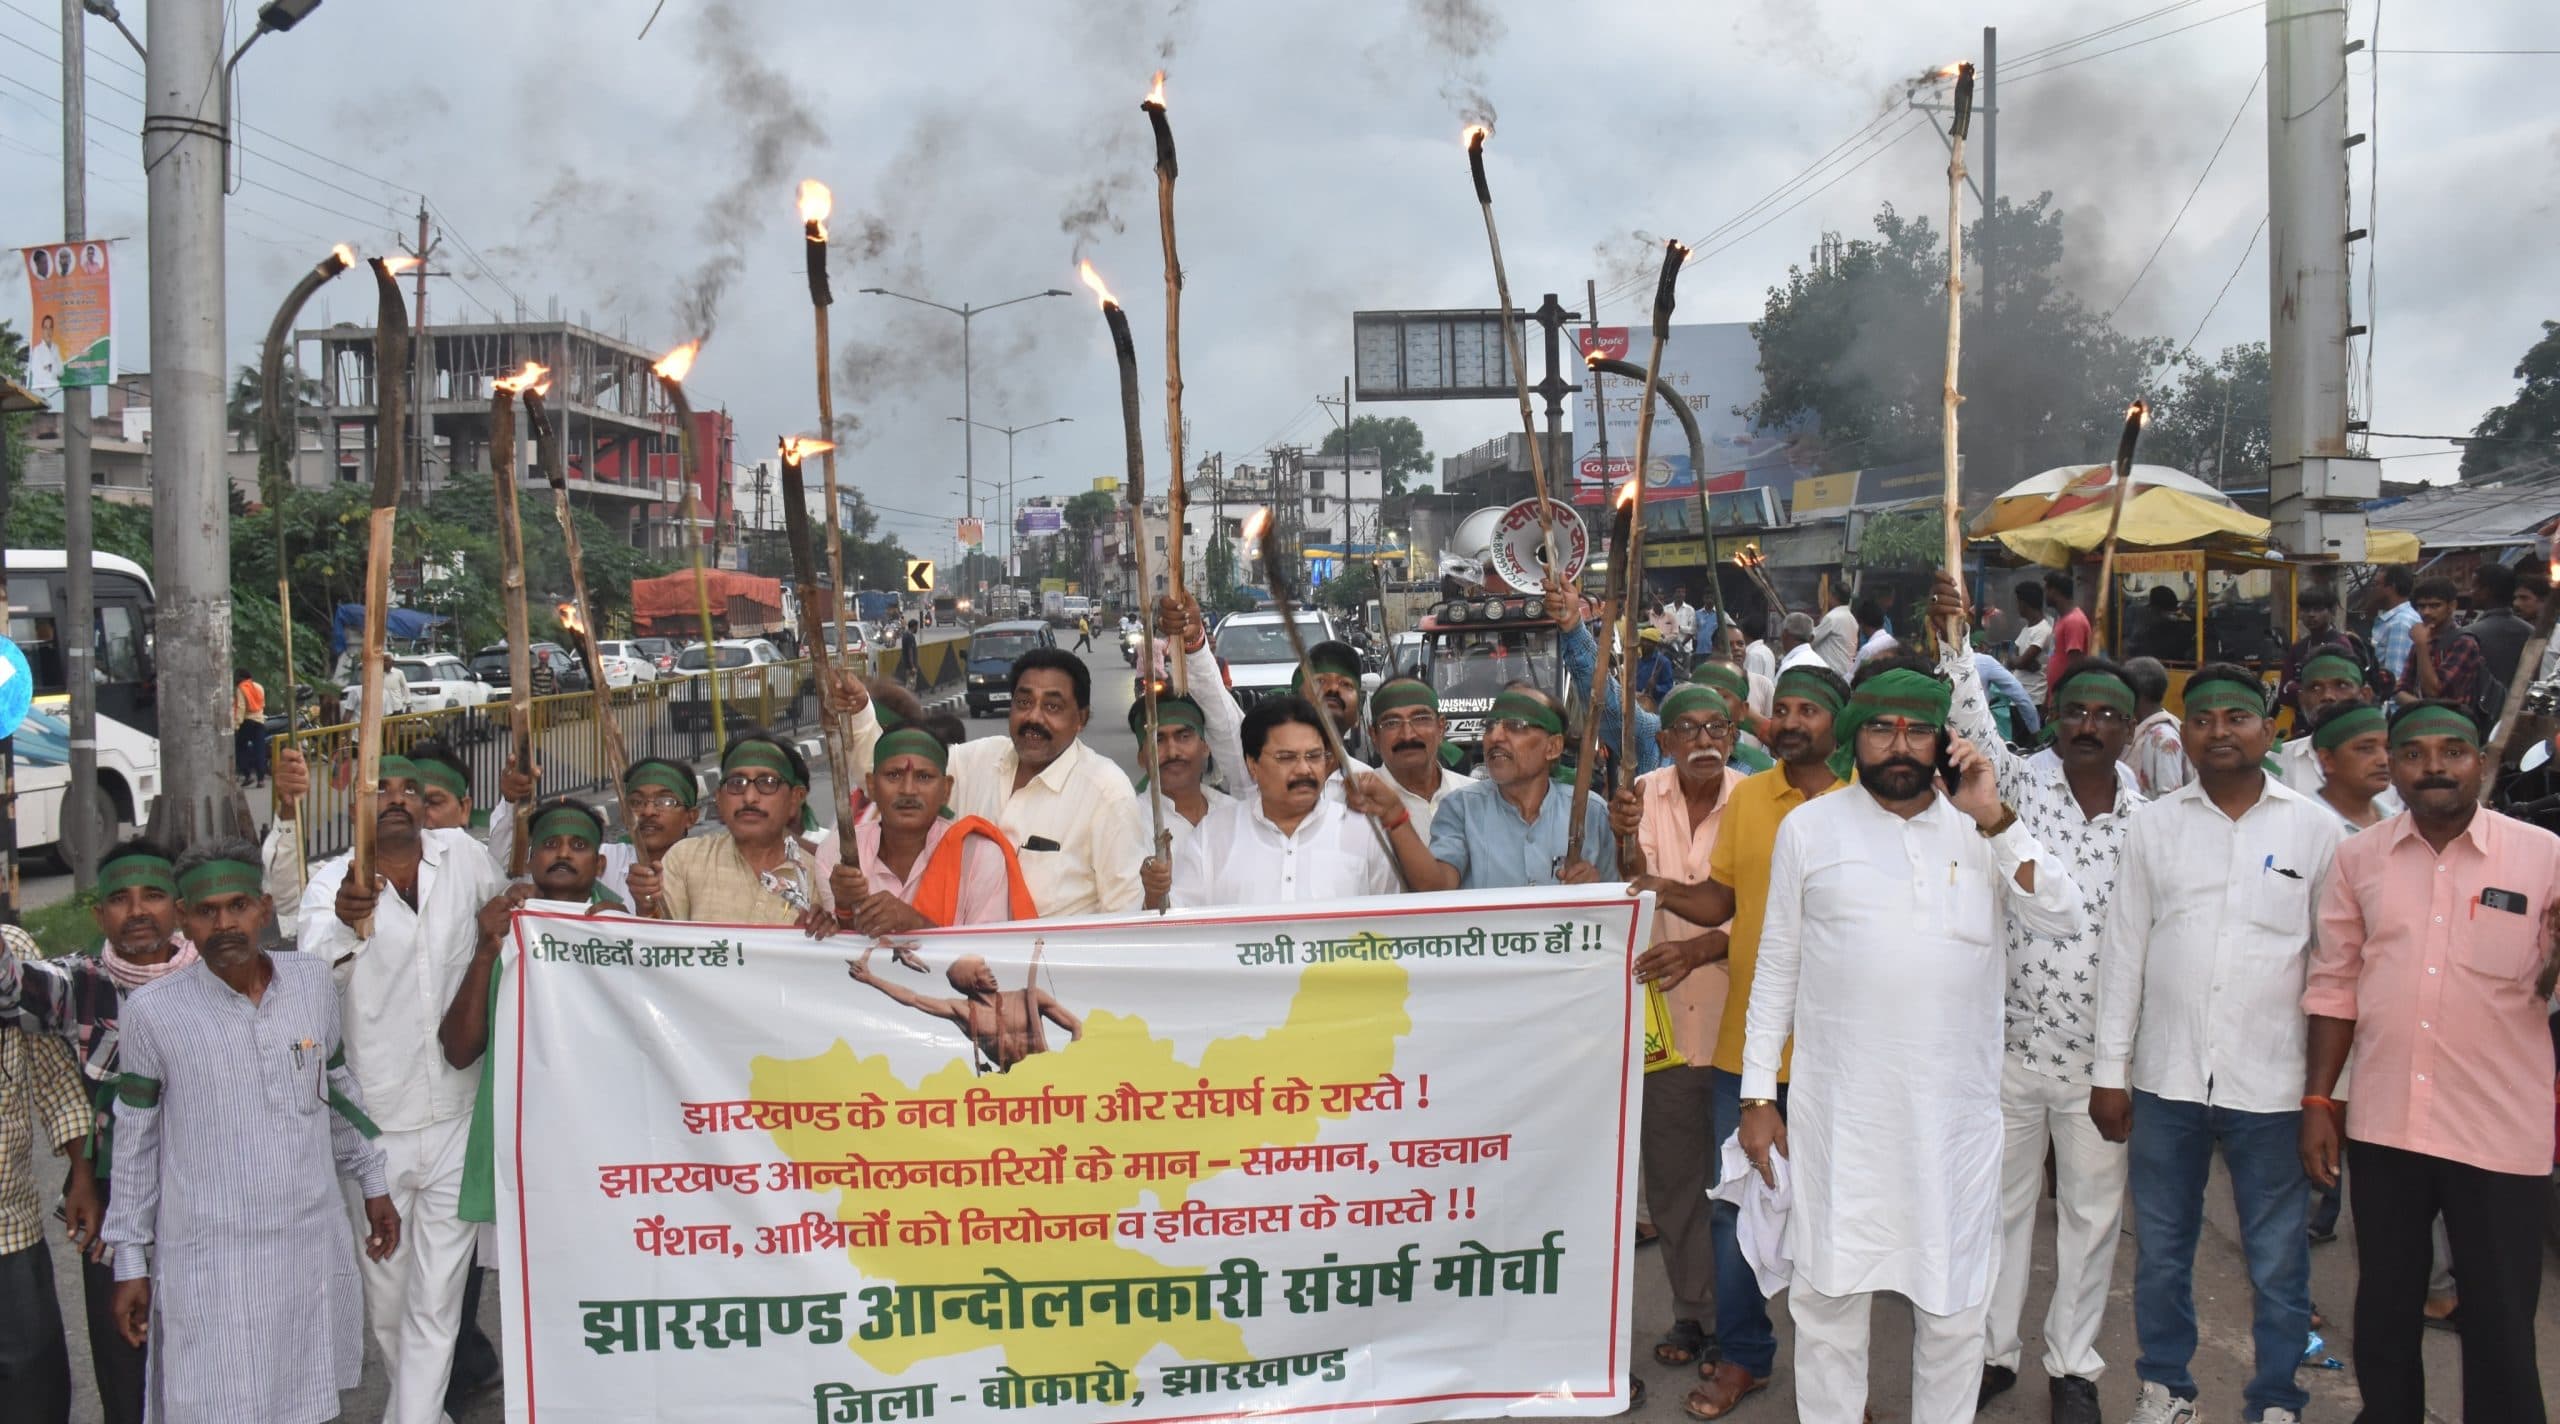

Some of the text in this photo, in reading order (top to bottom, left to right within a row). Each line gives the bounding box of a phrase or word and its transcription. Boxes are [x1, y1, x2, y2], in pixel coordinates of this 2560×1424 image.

[1585, 337, 1624, 346] Clgate
[2173, 553, 2194, 570] TEA
[573, 938, 634, 966] शहिदों
[639, 945, 695, 967] अमर
[697, 939, 729, 967] रहें
[1235, 934, 1296, 966] सभी
[1301, 927, 1487, 963] आन्दोलनकारी
[1491, 932, 1539, 957] एक
[1544, 921, 1574, 954] हों
[681, 1100, 842, 1135] झारखण्ड
[845, 1092, 888, 1130] के
[895, 1099, 957, 1129] नव
[963, 1084, 1088, 1127] निर्माण
[1094, 1081, 1168, 1123] और
[1172, 1076, 1266, 1119] संघर्ष
[1271, 1077, 1313, 1115] के
[1319, 1073, 1406, 1113] रास्ते
[599, 1161, 762, 1199] झारखण्ड
[766, 1144, 1069, 1192] आन्दोलनकारियों
[1073, 1145, 1116, 1183] के
[1123, 1151, 1200, 1181] मान
[1240, 1142, 1380, 1177] सम्मान,
[1389, 1134, 1512, 1169] पहचान
[633, 1214, 745, 1258] पेंशन,
[754, 1208, 892, 1256] आश्रितों
[897, 1210, 952, 1247] को
[958, 1207, 1110, 1247] नियोजन
[1118, 1212, 1146, 1240] व
[1153, 1199, 1293, 1243] इतिहास
[1298, 1194, 1340, 1230] के
[1346, 1188, 1436, 1228] वास्ते
[579, 1230, 1566, 1355] झारखण्ड आन्दोलनकारी संघर्ष मोर्चा
[813, 1382, 938, 1424] जिला
[980, 1360, 1145, 1409] बोकारो,
[1160, 1347, 1349, 1398] झारखण्ड
